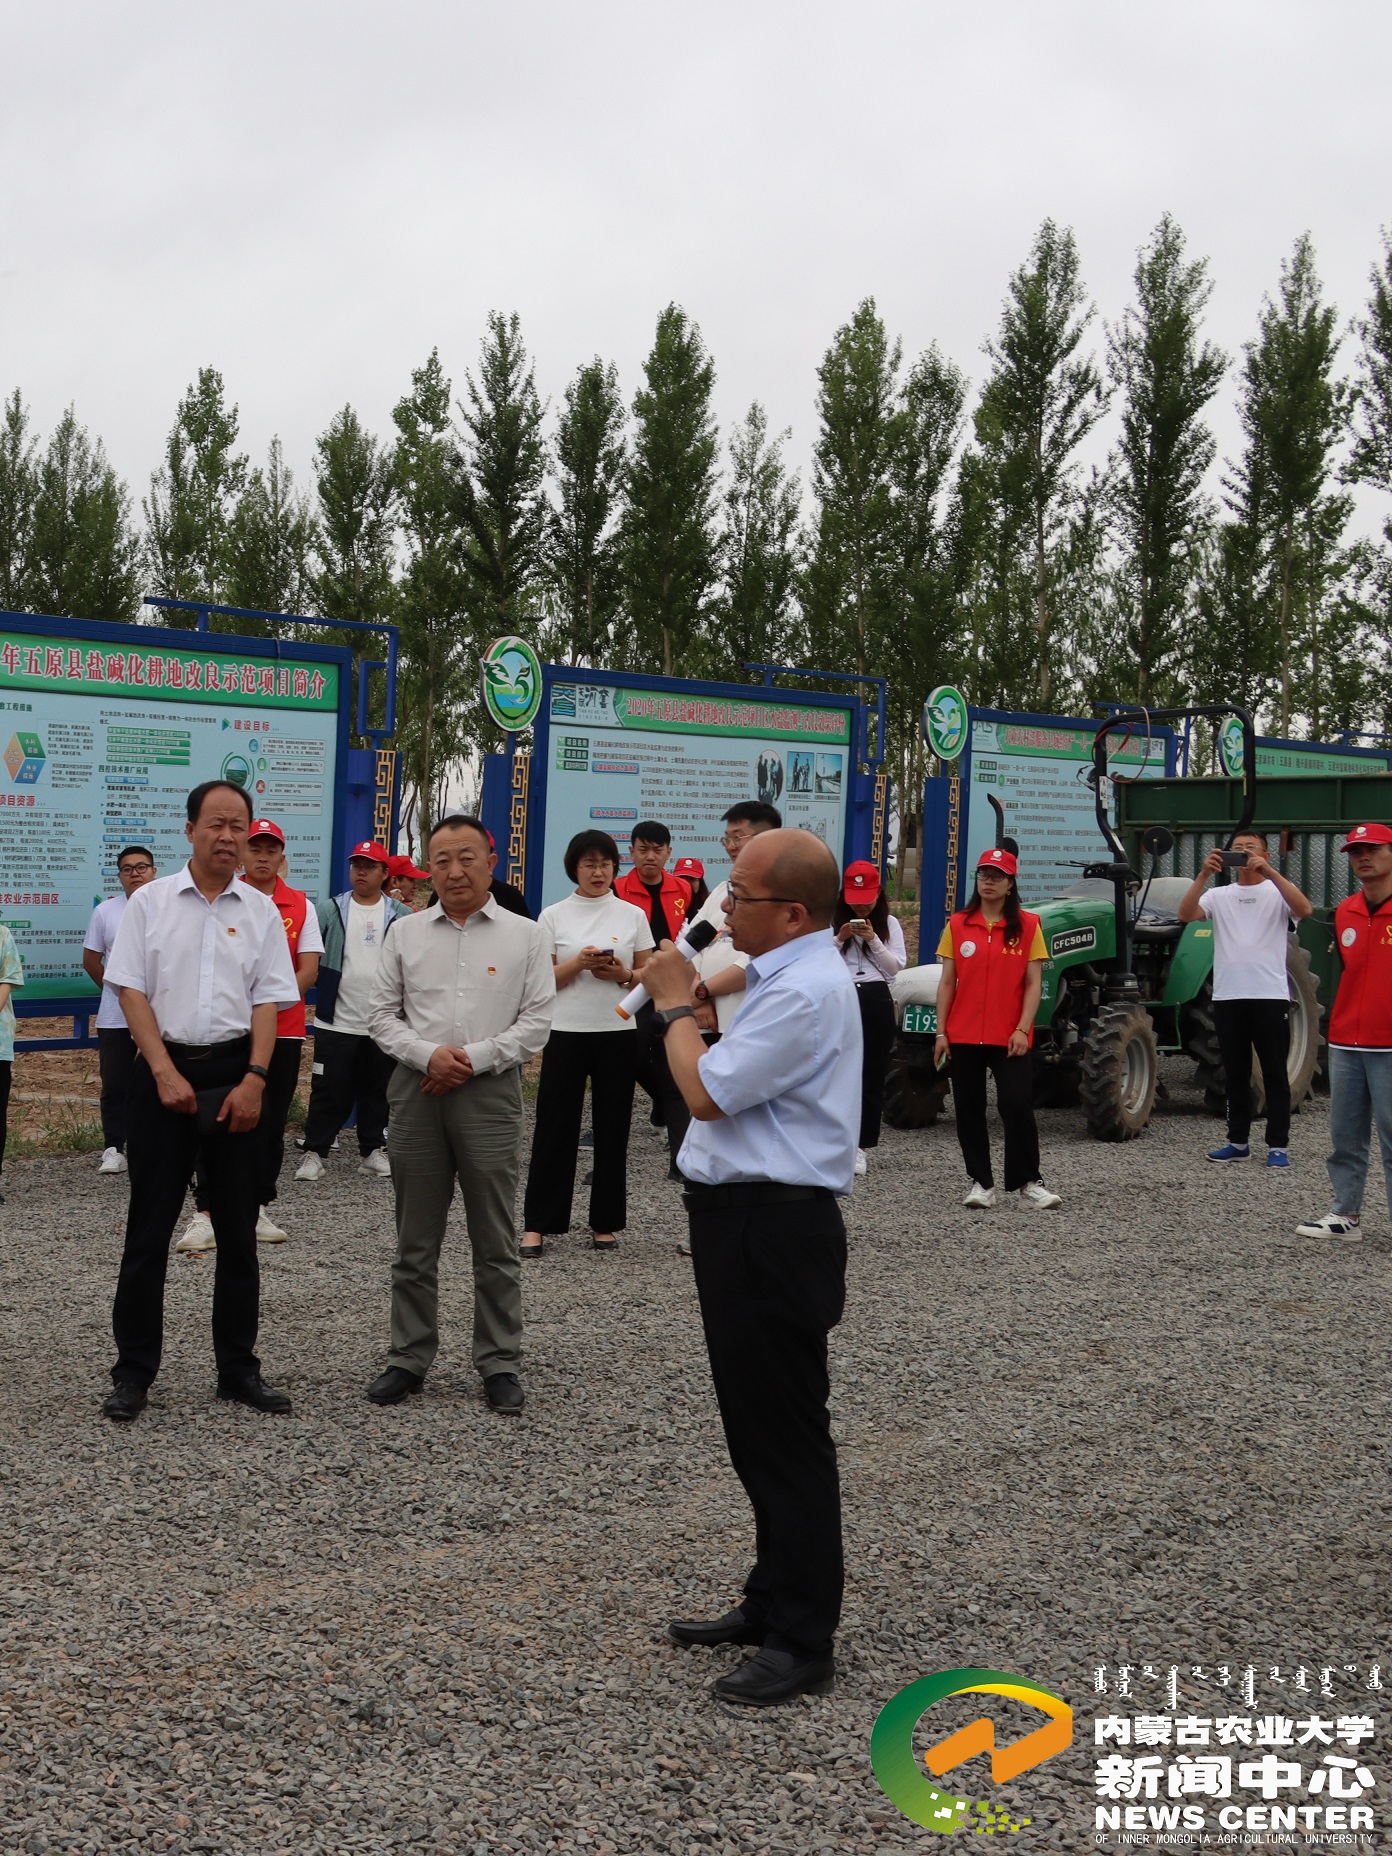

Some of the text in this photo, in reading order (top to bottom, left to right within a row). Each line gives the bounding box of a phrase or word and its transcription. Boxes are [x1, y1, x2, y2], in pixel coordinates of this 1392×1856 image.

[234, 719, 271, 732] 建设目标
[98, 765, 149, 775] 四控技术推广应用
[1053, 933, 1093, 950] CFC504B
